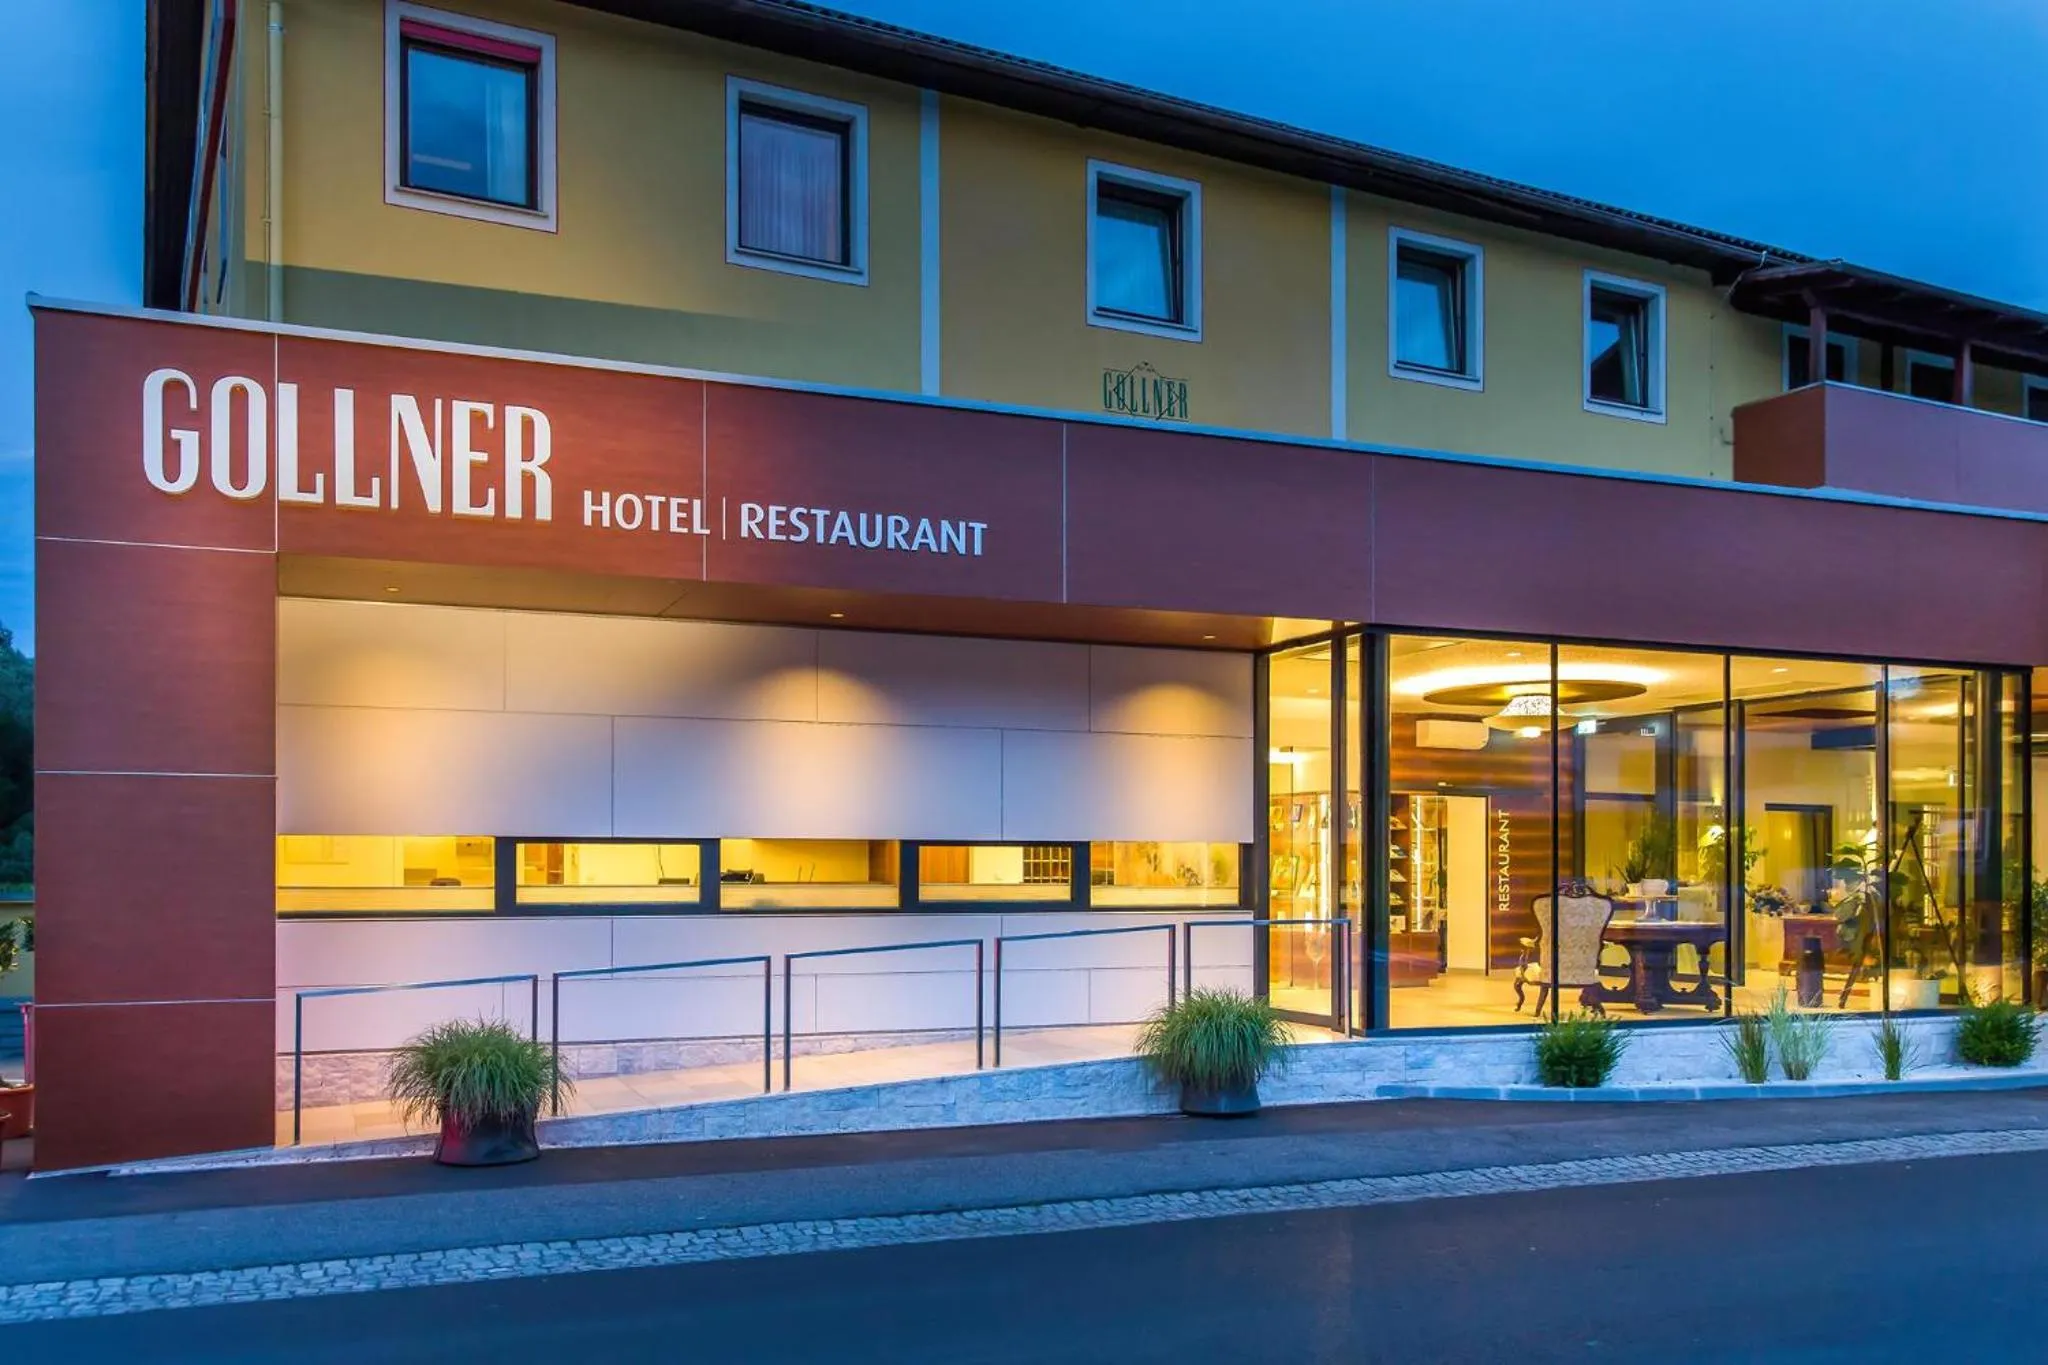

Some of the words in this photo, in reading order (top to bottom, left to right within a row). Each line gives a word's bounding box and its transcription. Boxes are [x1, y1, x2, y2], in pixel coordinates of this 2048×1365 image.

[1103, 370, 1188, 419] GOLLNER
[143, 368, 553, 521] GOLLNER
[583, 489, 711, 536] HOTEL
[740, 502, 988, 556] RESTAURANT
[1498, 809, 1511, 912] RESTAURANT
